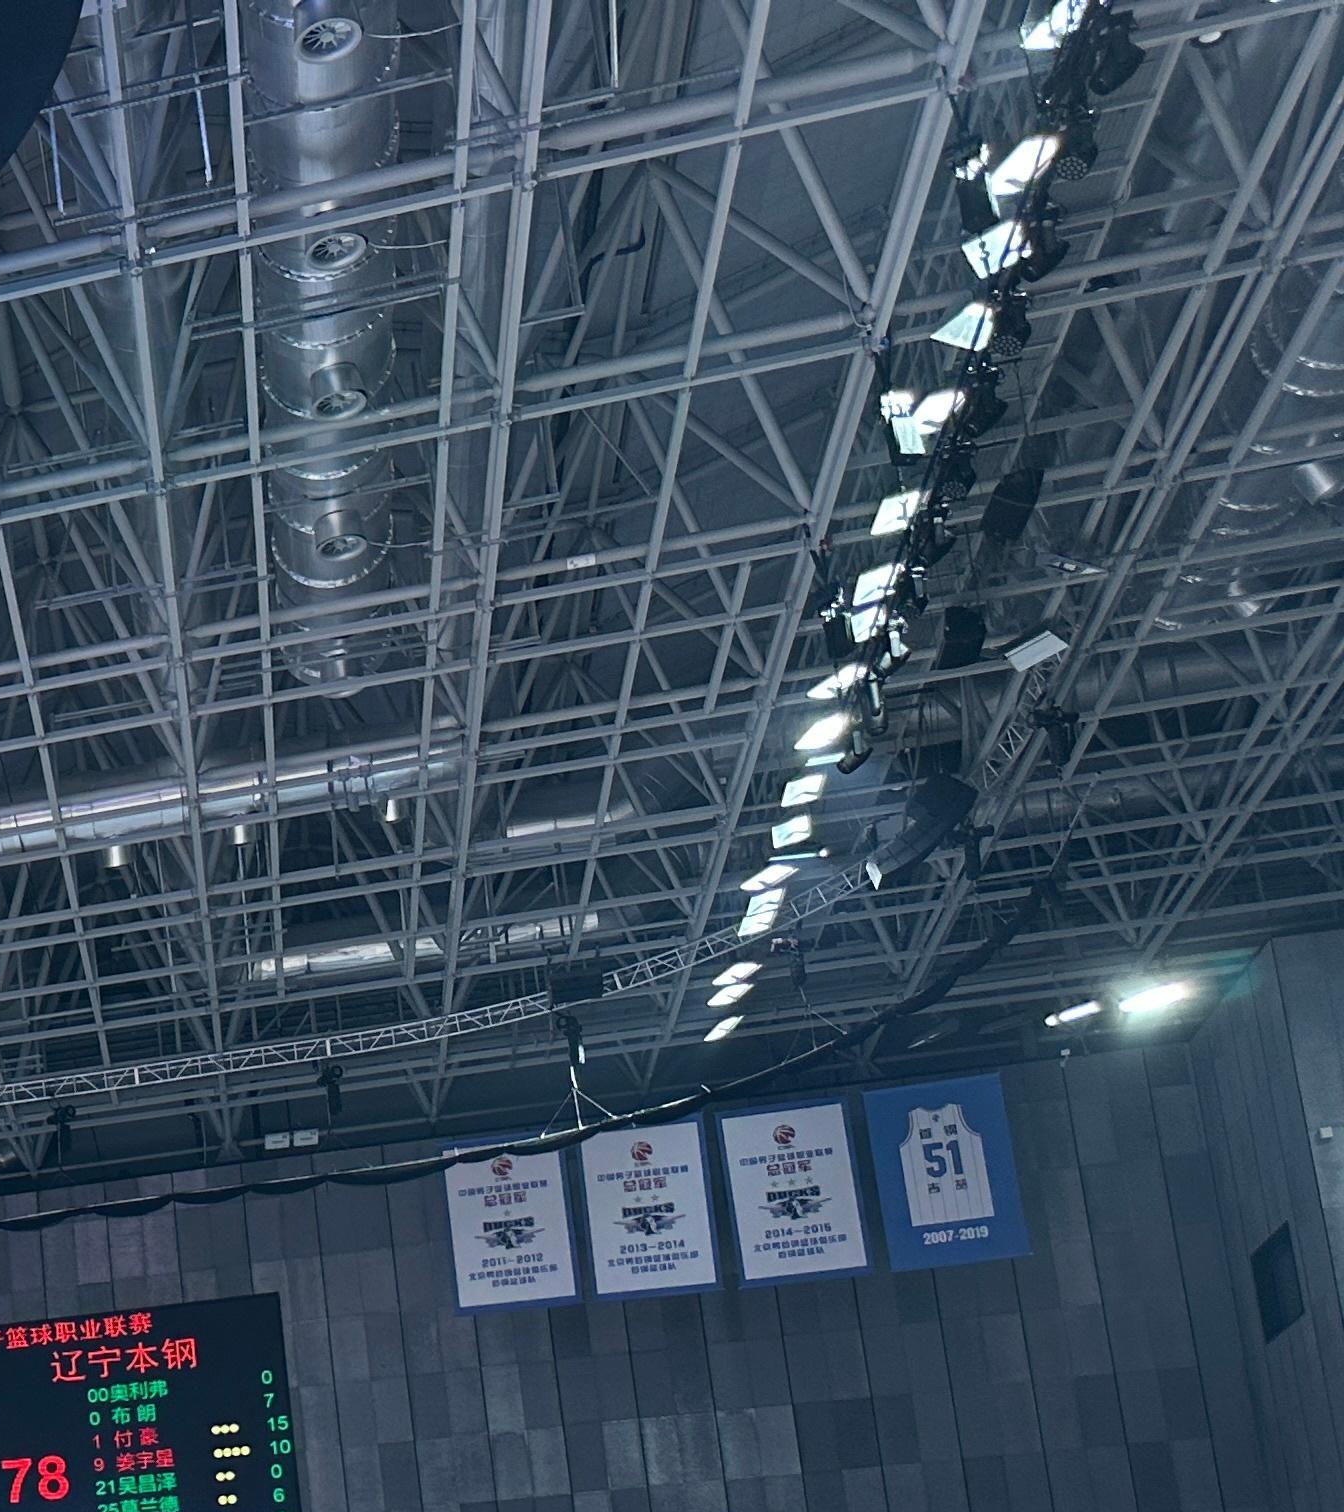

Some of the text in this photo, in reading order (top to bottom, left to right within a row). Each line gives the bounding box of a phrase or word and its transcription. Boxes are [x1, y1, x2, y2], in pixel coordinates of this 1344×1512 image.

[922, 1139, 963, 1178] 51
[766, 1185, 821, 1203] DUCKS
[622, 1202, 675, 1219] DUCKS
[483, 1216, 535, 1233] DUCKS
[923, 1225, 989, 1245] 2007-2019
[50, 1337, 198, 1383] 辽宁本钢
[261, 1369, 273, 1384] 0
[90, 1412, 100, 1426] 0
[264, 1393, 274, 1408] 7
[267, 1415, 289, 1431] 15
[94, 1458, 104, 1472] 9
[270, 1439, 291, 1455] 10
[0, 1455, 70, 1504] 78
[271, 1464, 283, 1479] 0
[273, 1488, 285, 1503] 6
